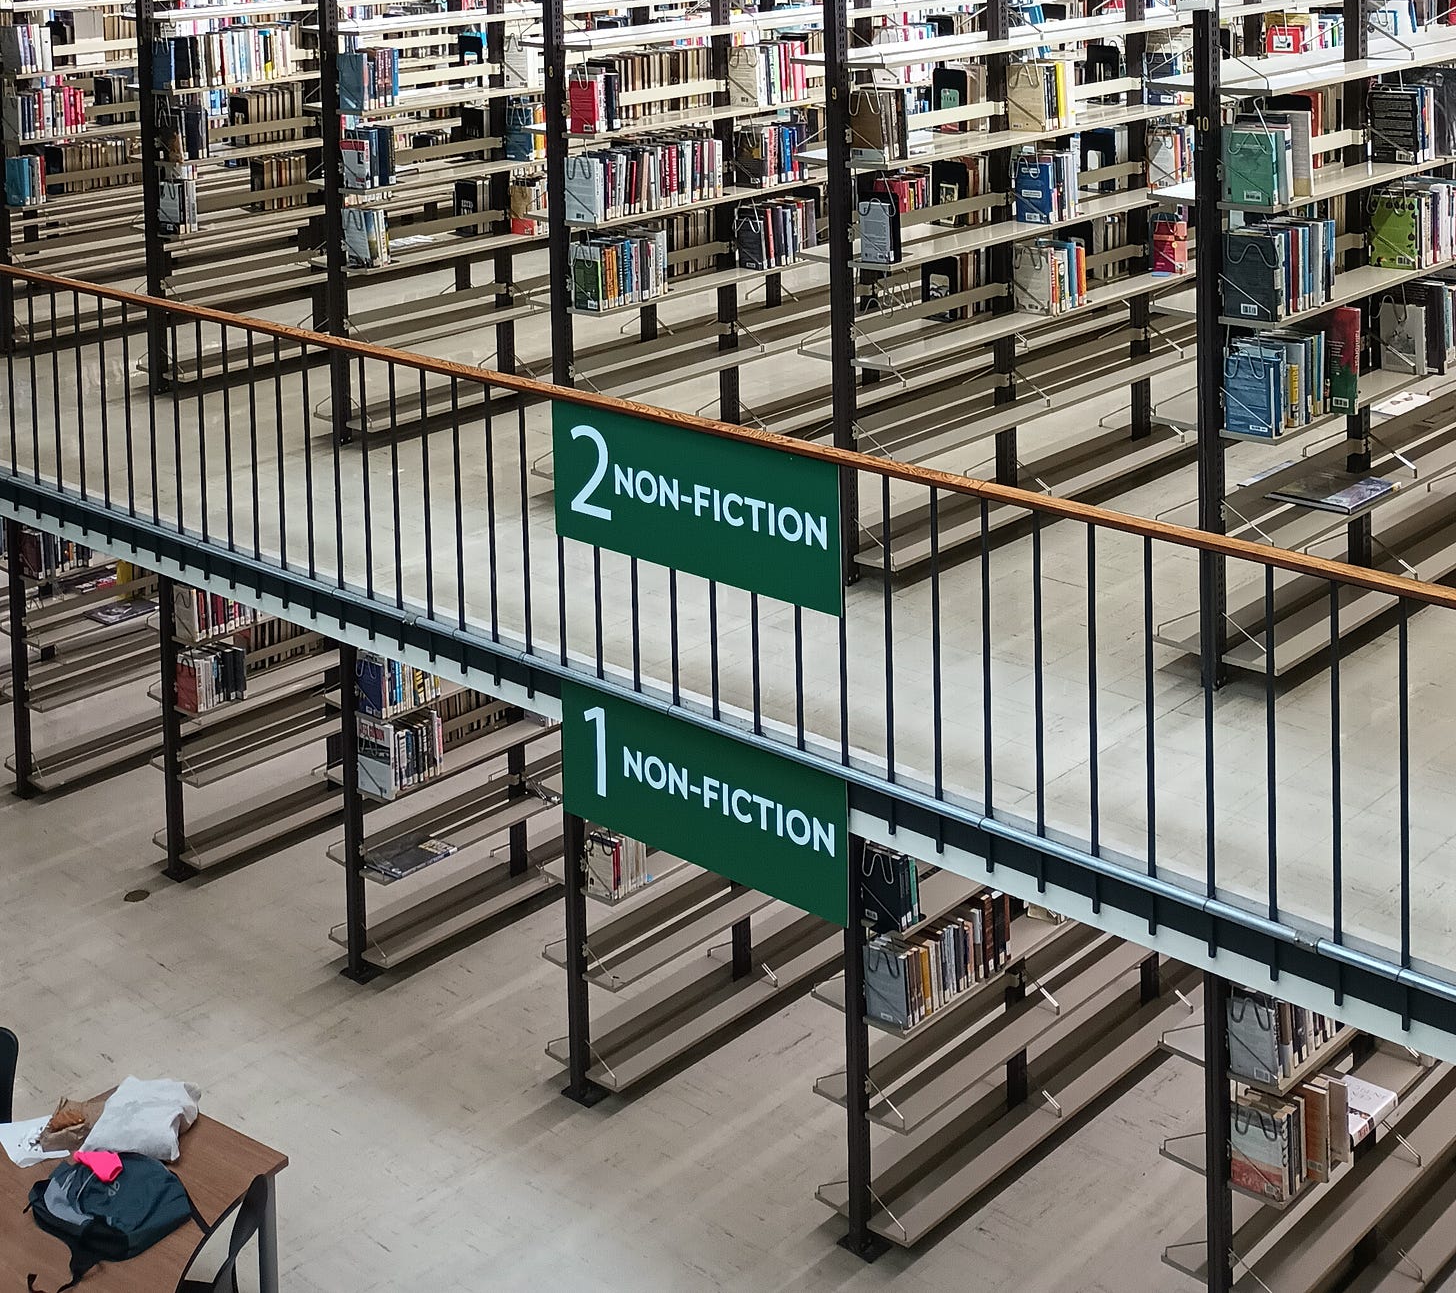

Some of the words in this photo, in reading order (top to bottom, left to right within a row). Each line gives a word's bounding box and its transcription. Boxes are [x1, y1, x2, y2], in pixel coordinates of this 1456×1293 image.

[831, 86, 838, 100] 9
[1196, 116, 1209, 132] 10
[570, 424, 612, 521] 2
[614, 463, 829, 551] NON-FICTION
[584, 706, 607, 798] 1
[623, 746, 836, 858] NON-FICTION
